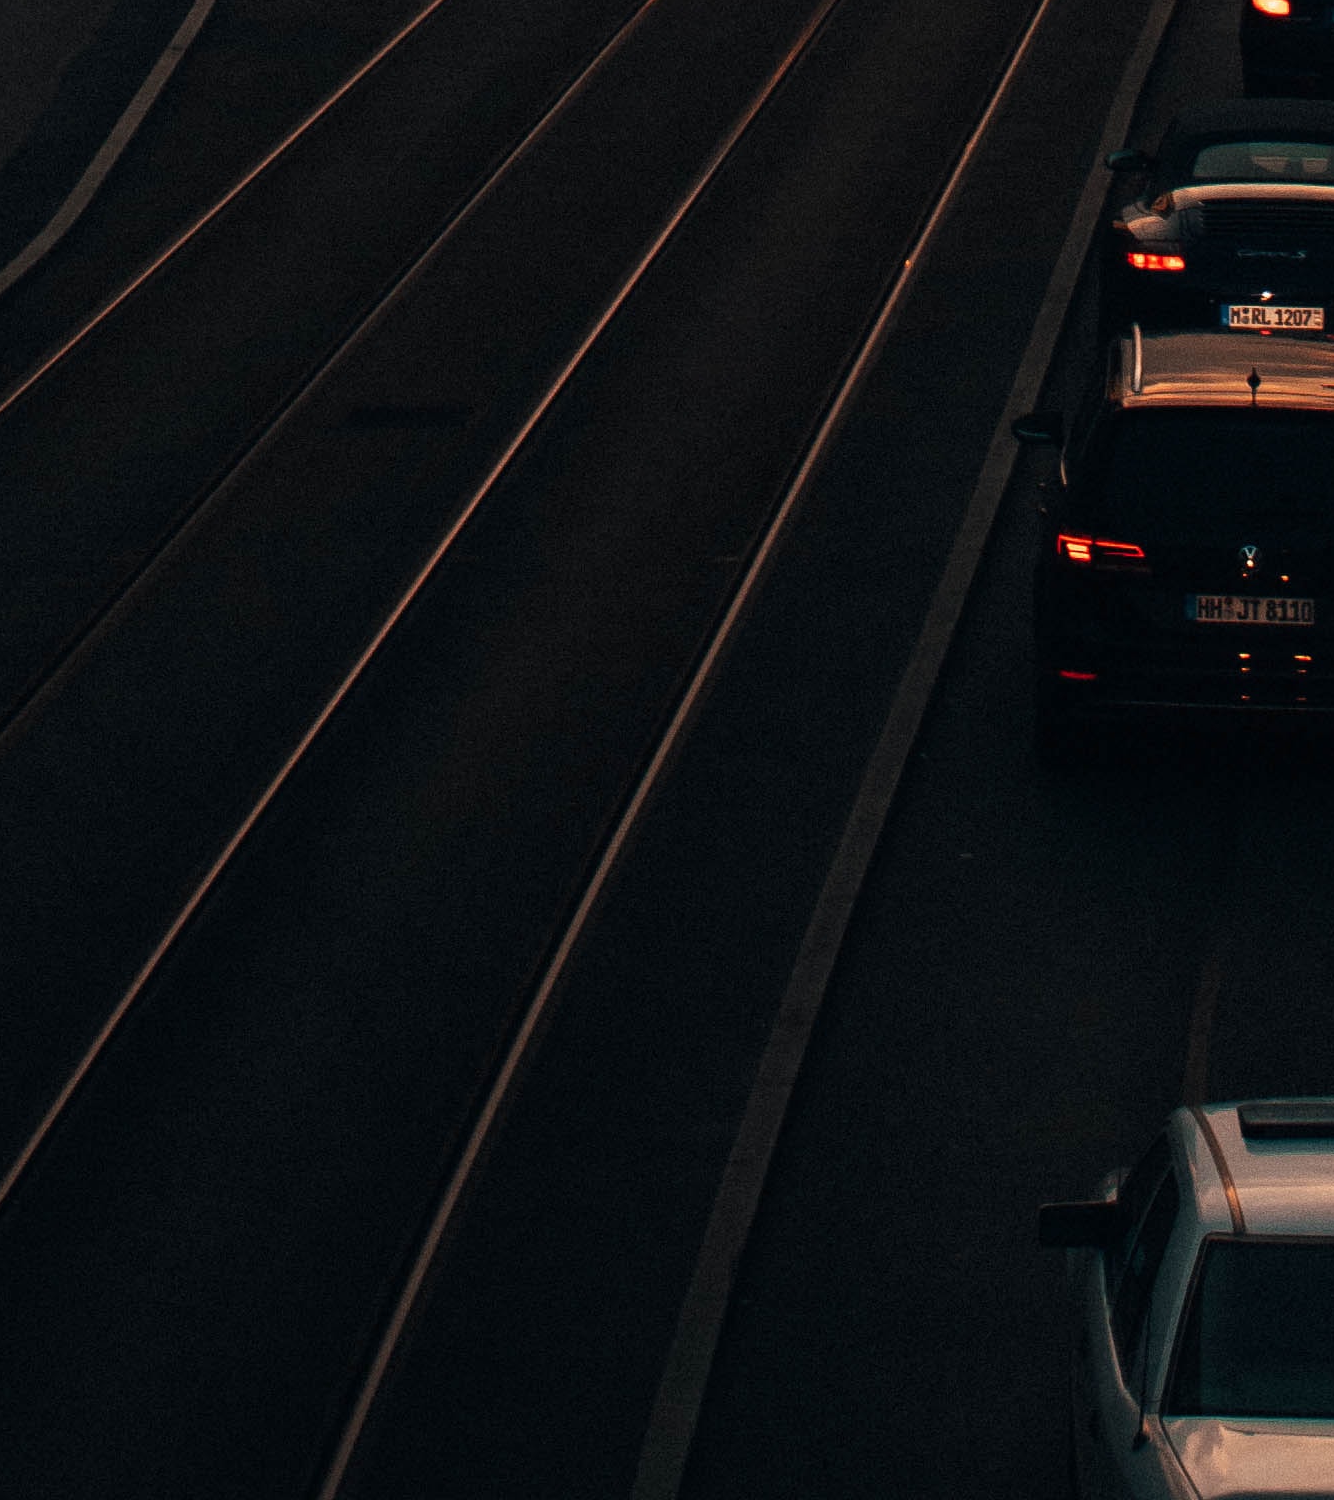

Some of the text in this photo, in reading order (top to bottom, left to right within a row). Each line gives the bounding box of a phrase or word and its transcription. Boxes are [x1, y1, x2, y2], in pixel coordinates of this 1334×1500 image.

[1231, 308, 1312, 326] M RL 1207
[1199, 597, 1312, 622] HH JT 8110
